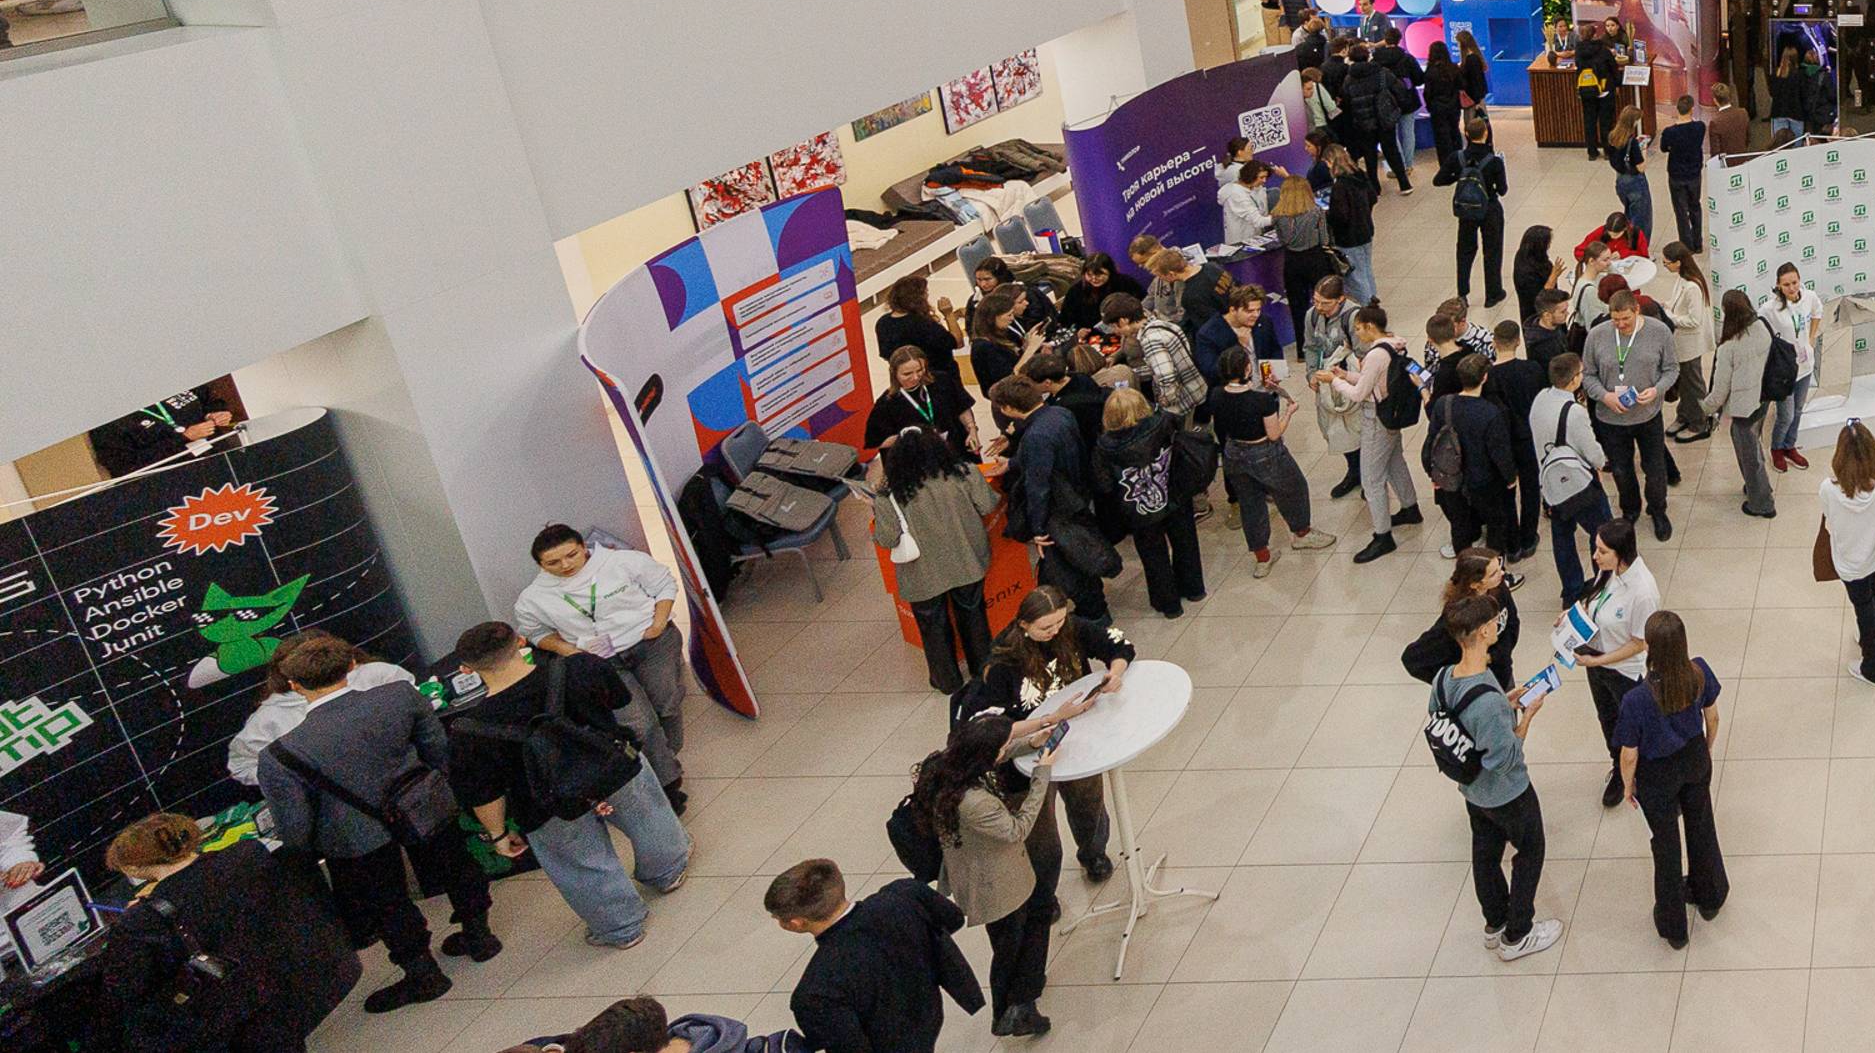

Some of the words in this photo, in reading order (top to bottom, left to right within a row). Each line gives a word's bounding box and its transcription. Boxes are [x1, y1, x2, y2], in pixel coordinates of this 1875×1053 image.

[1122, 180, 1140, 203] Твоя
[1141, 150, 1191, 185] карьера
[1126, 204, 1136, 223] на
[1135, 181, 1165, 212] новой
[1167, 155, 1218, 188] высоте!
[188, 507, 251, 531] Dev
[73, 560, 173, 604] Python
[84, 577, 185, 622] Ansible
[89, 595, 188, 640] Docker
[101, 624, 165, 659] Junit
